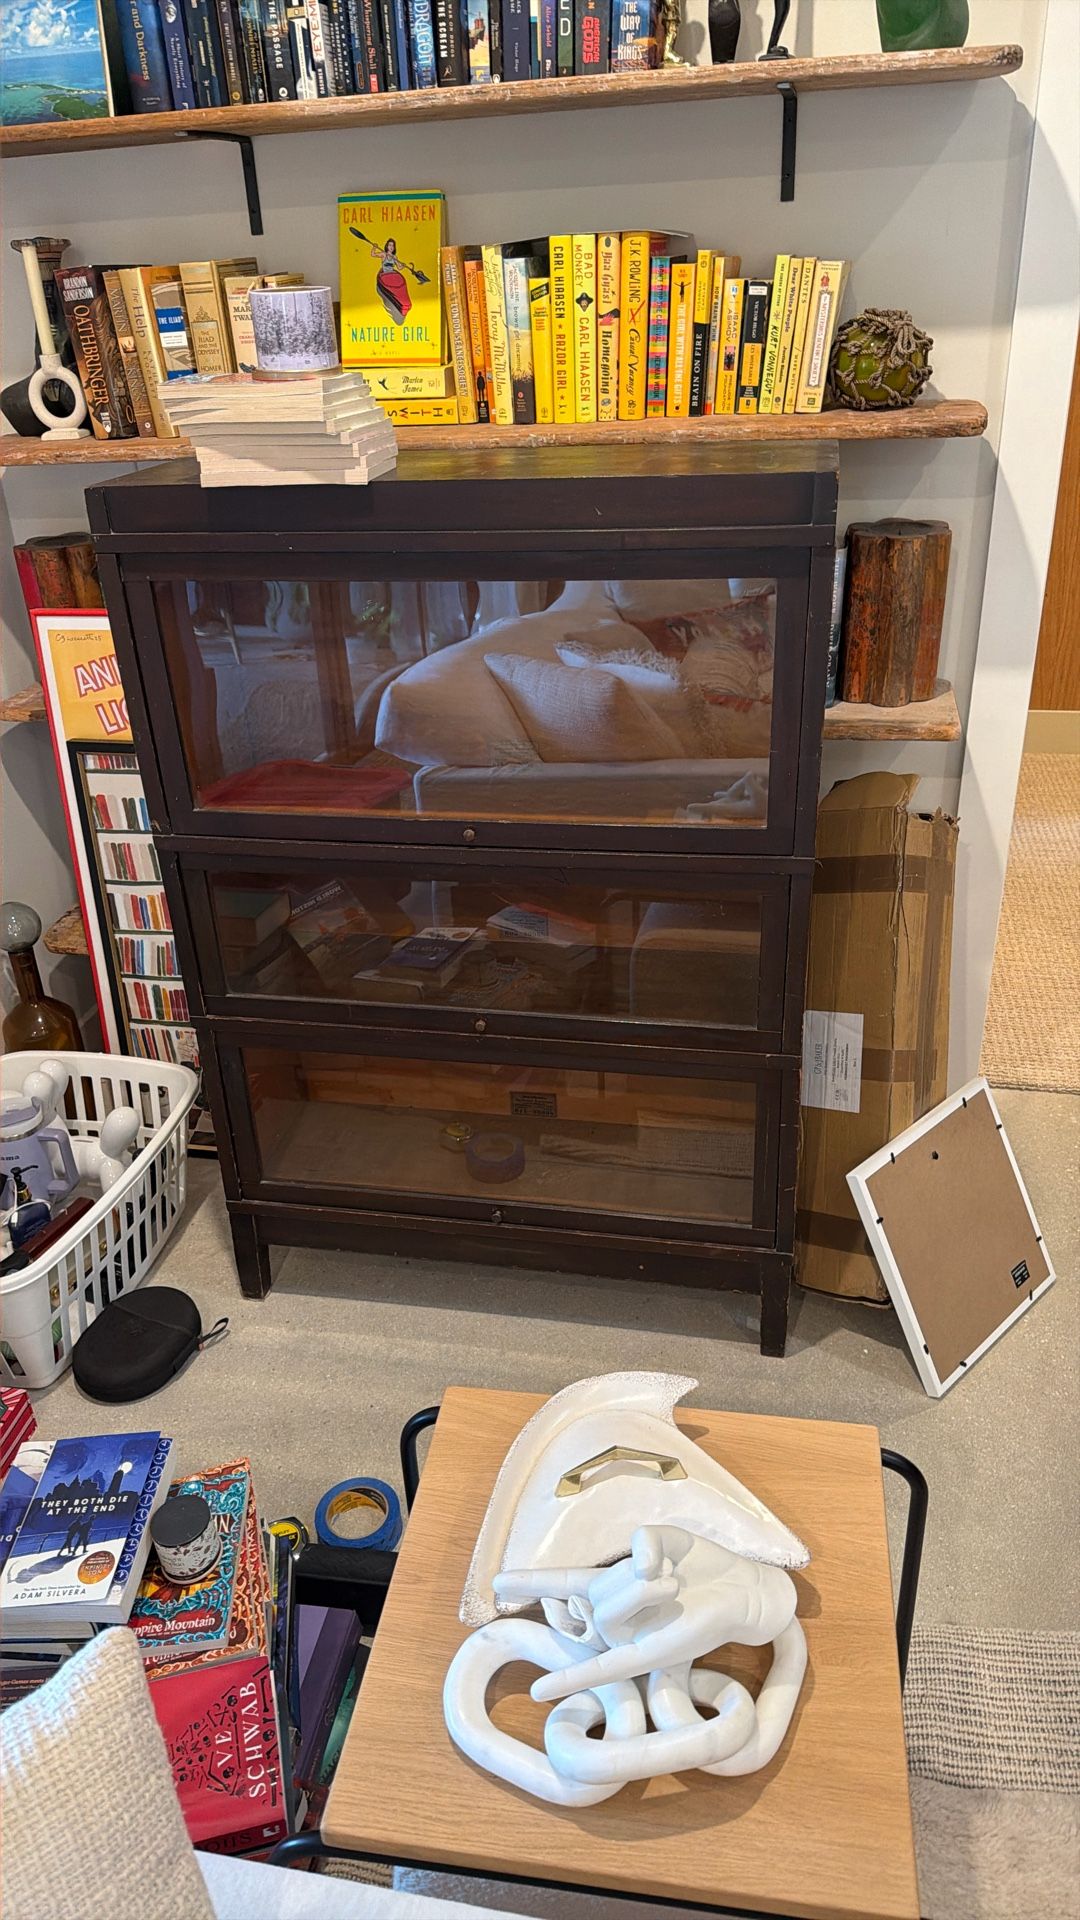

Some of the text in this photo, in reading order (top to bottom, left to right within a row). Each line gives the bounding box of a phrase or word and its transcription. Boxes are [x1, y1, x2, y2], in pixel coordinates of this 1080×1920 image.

[132, 8, 143, 29] and
[625, 2, 637, 13] THE
[438, 1, 448, 58] THE SCREAM
[449, 22, 454, 32] ON
[620, 15, 640, 31] WAY
[268, 0, 284, 69] THE PASSAGE
[582, 16, 594, 64] GODS
[626, 34, 634, 43] OF
[136, 32, 150, 81] Darkness
[368, 47, 376, 70] Skull
[618, 46, 642, 60] KINGS
[343, 205, 436, 224] CARL HIAASEN
[574, 244, 584, 288] MONKEY
[584, 252, 594, 279] BAD
[63, 276, 88, 290] BRANDON
[601, 252, 614, 304] Yaa Gyasi
[62, 286, 94, 302] SANDERSON
[788, 287, 796, 309] White
[110, 288, 128, 332] MARTIN
[131, 288, 148, 338] The Help
[158, 316, 182, 325] THE ILIAD
[554, 246, 566, 391] CARL HIAASEN RAZOR GIRL
[784, 309, 793, 333] People
[352, 326, 430, 342] NATURE GIRL
[472, 312, 482, 357] Harbor Me
[676, 318, 686, 336] GIRL
[198, 336, 214, 344] ILIAD
[451, 304, 461, 334] LONDON
[458, 362, 468, 397] SOCIETY
[489, 306, 507, 396] Terry McMillan
[74, 304, 110, 406] OATHBRINGER
[580, 317, 590, 402] CARL HIAASEN
[600, 330, 613, 395] Homegoing
[626, 328, 641, 396] Casual Vacancy
[763, 324, 780, 394] KURT VONNEGUT
[694, 359, 701, 374] ON
[402, 376, 424, 384] Marlon
[402, 384, 423, 393] James
[692, 376, 700, 407] BRAIN
[388, 407, 444, 420] SMITH
[41, 1495, 128, 1509] THEY BOTH DIE
[46, 1504, 116, 1516] AT THE END
[12, 1588, 87, 1600] ADAM SILVERA
[134, 1622, 163, 1637] mpire
[164, 1615, 216, 1632] Mountain
[240, 1682, 266, 1798] SCHWAB
